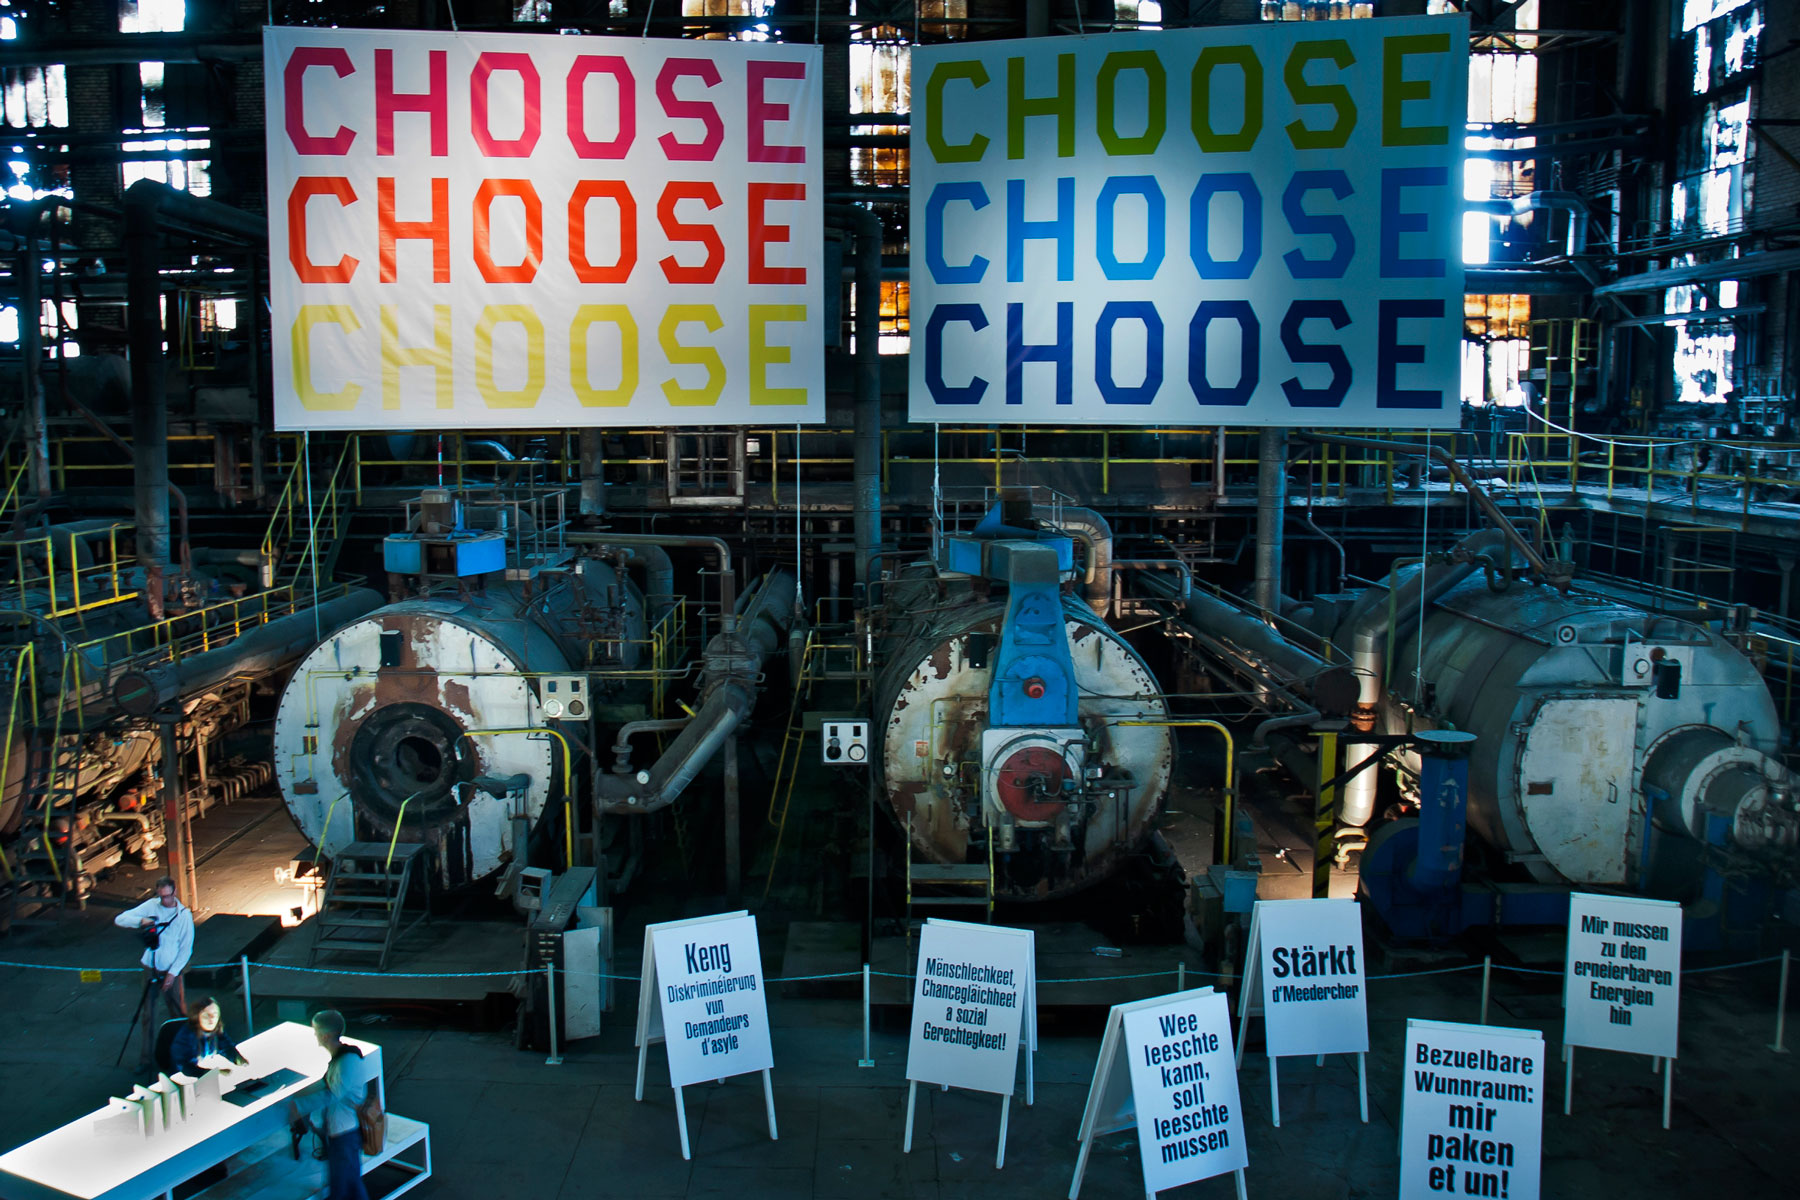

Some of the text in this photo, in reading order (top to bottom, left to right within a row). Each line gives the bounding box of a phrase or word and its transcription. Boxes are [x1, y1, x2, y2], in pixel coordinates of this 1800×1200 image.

[284, 46, 806, 163] CHOOSE
[925, 33, 1451, 163] CHOOSE
[287, 176, 807, 284] CHOOSE
[925, 166, 1449, 284] CHOOSE
[291, 304, 808, 410] CHOOSE
[925, 299, 1446, 409] CHOOSE
[1581, 914, 1669, 941] Mir mussen
[685, 942, 732, 974] Keng
[1272, 945, 1357, 978] Stärkt
[1600, 940, 1646, 961] zu den
[925, 957, 1016, 989] Mënschlechkeet,
[1574, 960, 1672, 986] erneierbaren
[667, 974, 757, 1003] Diskriminéierung
[922, 978, 1017, 1008] Chancegläichheet
[1272, 983, 1359, 1003] d'Meedercher
[1590, 981, 1654, 1006] Energien
[705, 999, 724, 1015] vun
[946, 1006, 988, 1027] a sozial
[1609, 1005, 1632, 1026] hin
[685, 1013, 749, 1039] Demandeurs
[923, 1021, 1007, 1051] Gerechtegkeet!
[1159, 1013, 1198, 1038] Wee
[701, 1033, 739, 1056] d'asyle
[1144, 1032, 1219, 1067] leeschte
[1416, 1043, 1533, 1075] Bezuelbare
[1160, 1061, 1210, 1088] kann,
[1414, 1070, 1534, 1104] Wunnraum:
[1172, 1082, 1205, 1111] soll
[1154, 1104, 1229, 1141] leeschte
[1449, 1102, 1497, 1132] mir
[1161, 1128, 1230, 1164] mussen
[1428, 1133, 1514, 1168] paken
[1428, 1164, 1510, 1200] et un!
